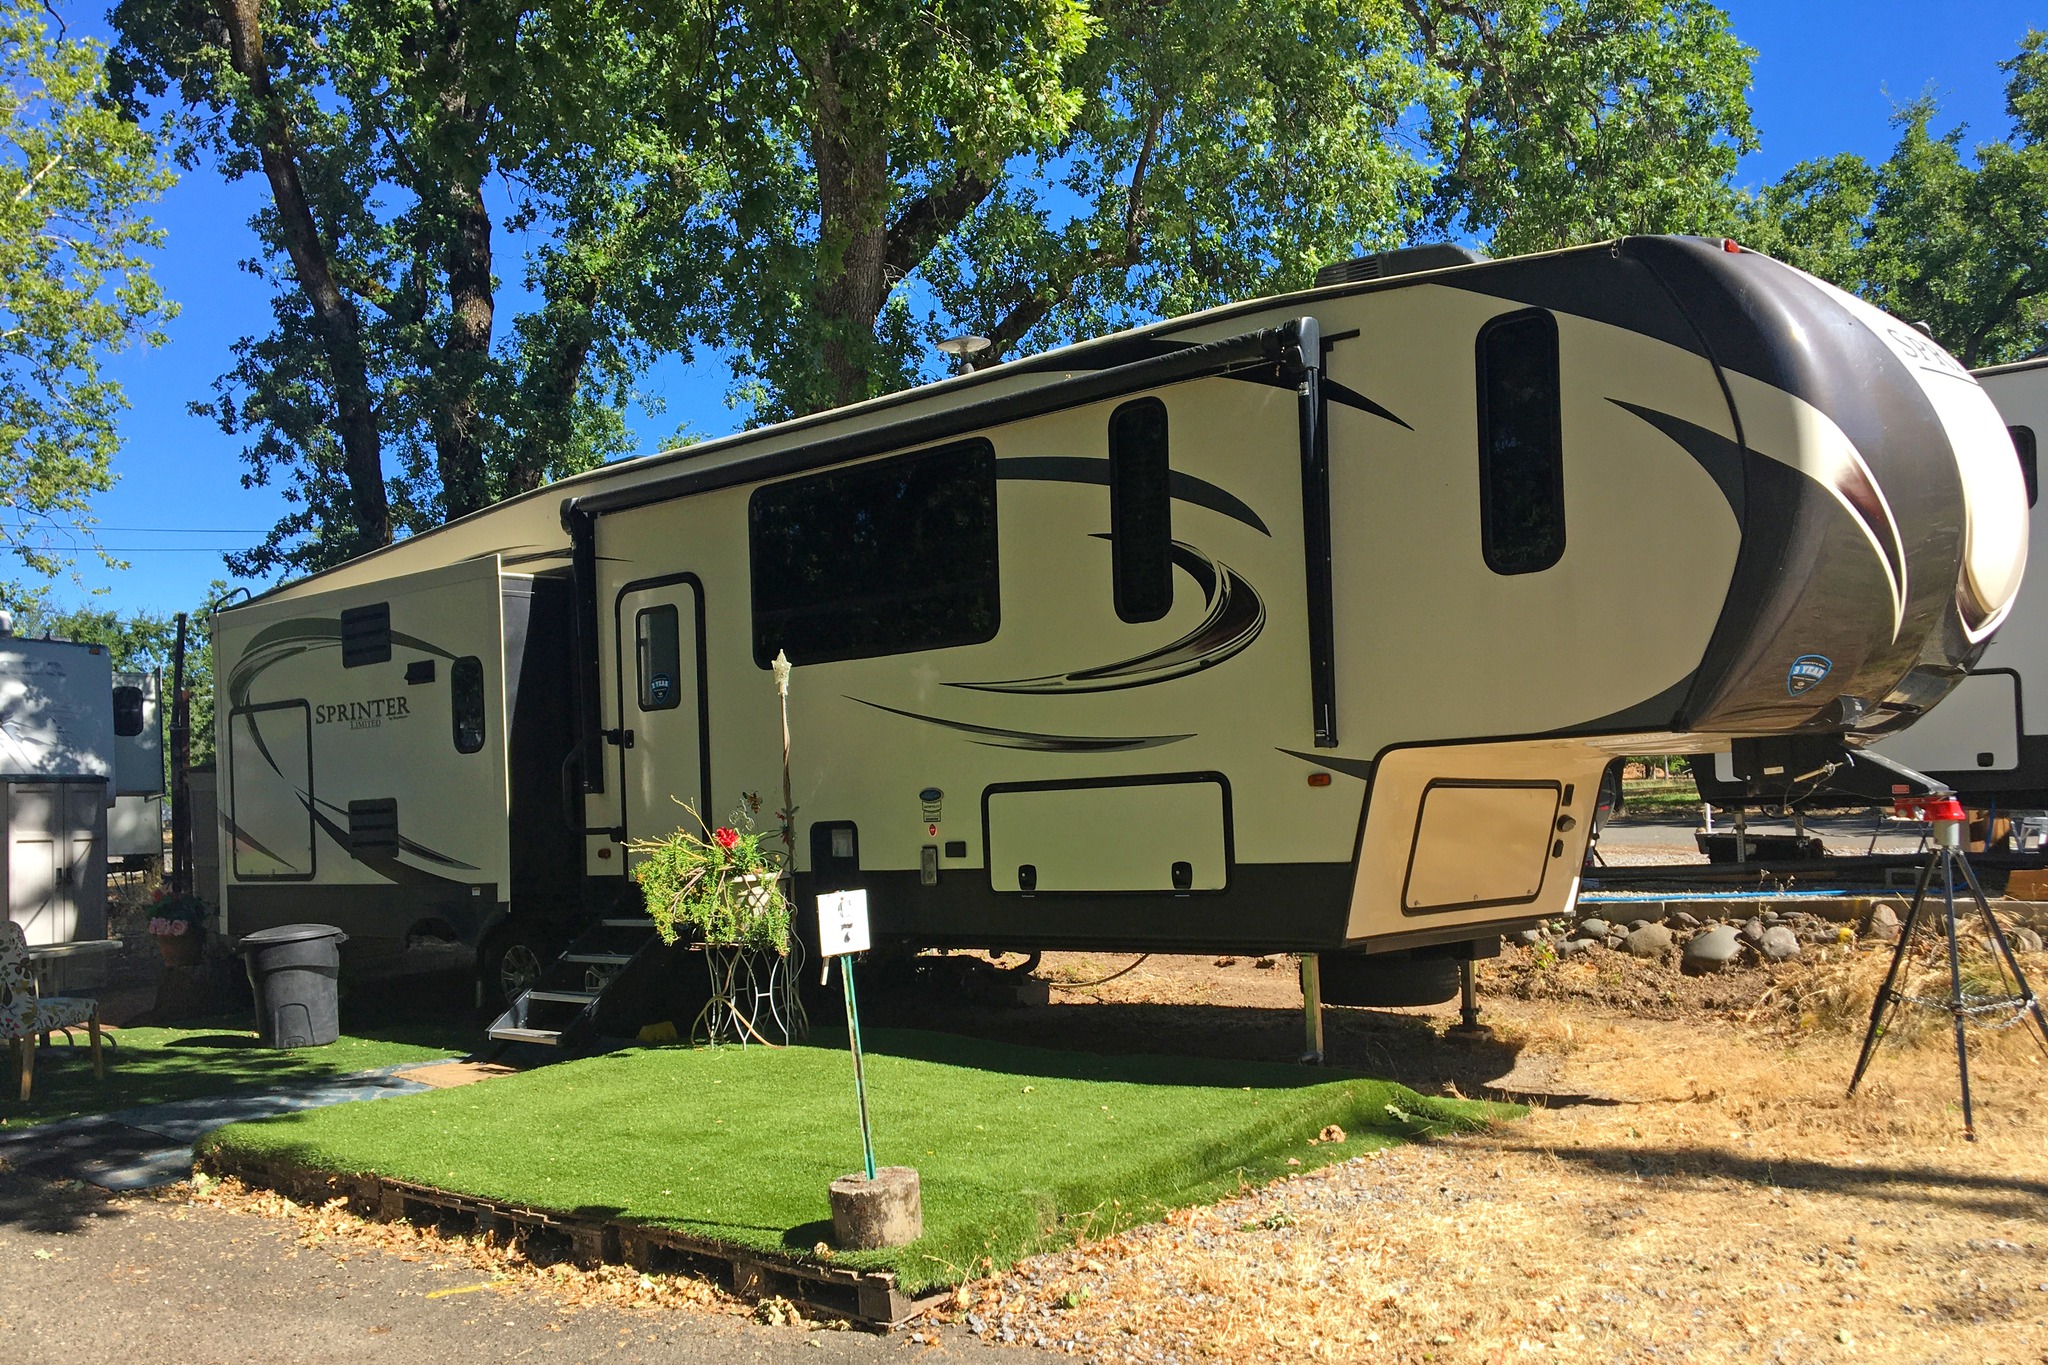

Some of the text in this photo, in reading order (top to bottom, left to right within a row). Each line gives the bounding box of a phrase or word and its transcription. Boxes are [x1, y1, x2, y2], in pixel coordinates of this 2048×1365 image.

[1793, 665, 1825, 678] 3 YEAR
[315, 696, 410, 724] SPRINTER
[350, 719, 382, 730] LIMITED
[840, 922, 853, 944] 7
